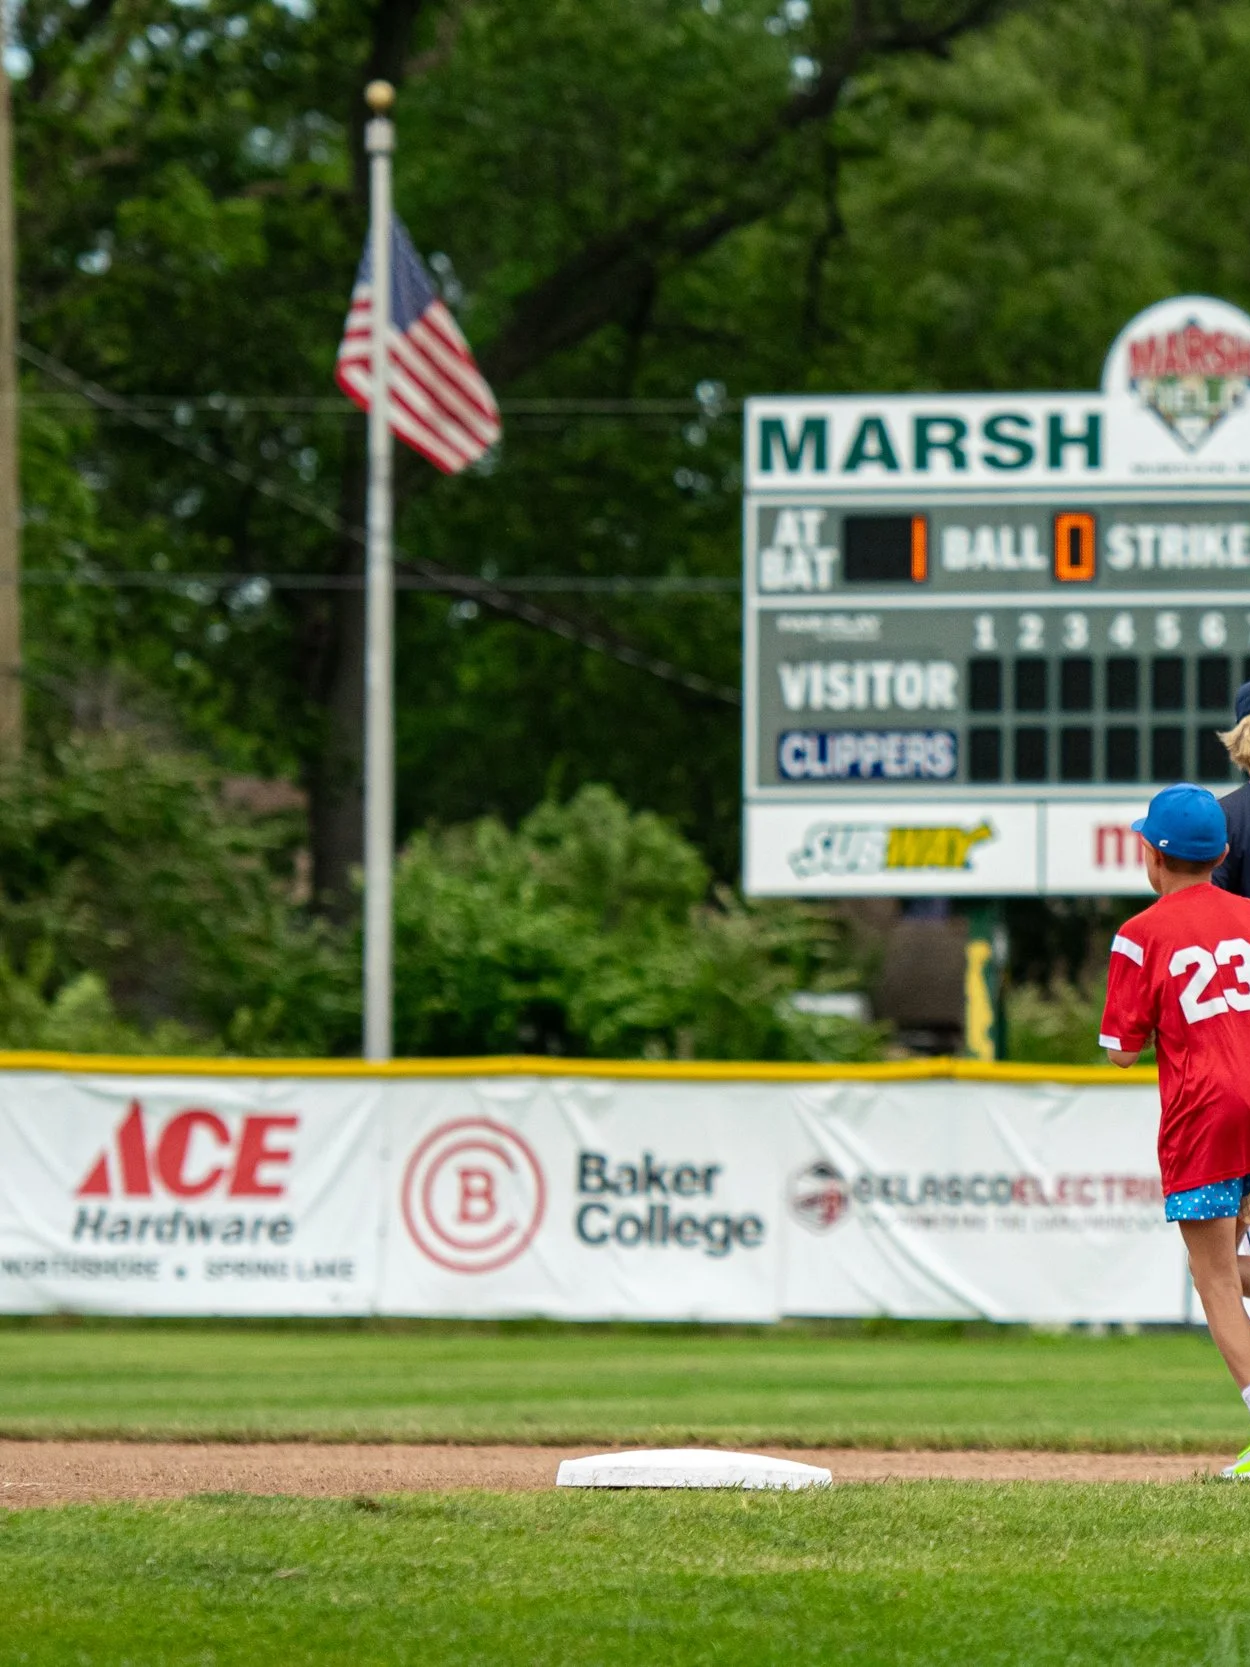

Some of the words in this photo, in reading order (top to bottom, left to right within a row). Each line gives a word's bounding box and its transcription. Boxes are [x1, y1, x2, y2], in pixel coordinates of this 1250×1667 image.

[758, 413, 1105, 473] MARSH
[772, 509, 826, 547] AT
[941, 524, 1048, 572] BALL
[1055, 512, 1095, 582] 0
[761, 547, 838, 591] BAT
[972, 613, 997, 650] 1
[1019, 613, 1045, 650] 2
[1062, 612, 1089, 649] 3
[1109, 612, 1136, 649] 4
[1154, 612, 1181, 649] 5
[1201, 611, 1227, 648] 6
[778, 660, 958, 711] VISITOR
[780, 732, 955, 778] CLIPPERS
[789, 820, 993, 878] SUBWAY
[75, 1098, 301, 1199] ACE
[577, 1149, 722, 1197] Baker
[72, 1206, 295, 1245] Hardware
[575, 1203, 765, 1257] College
